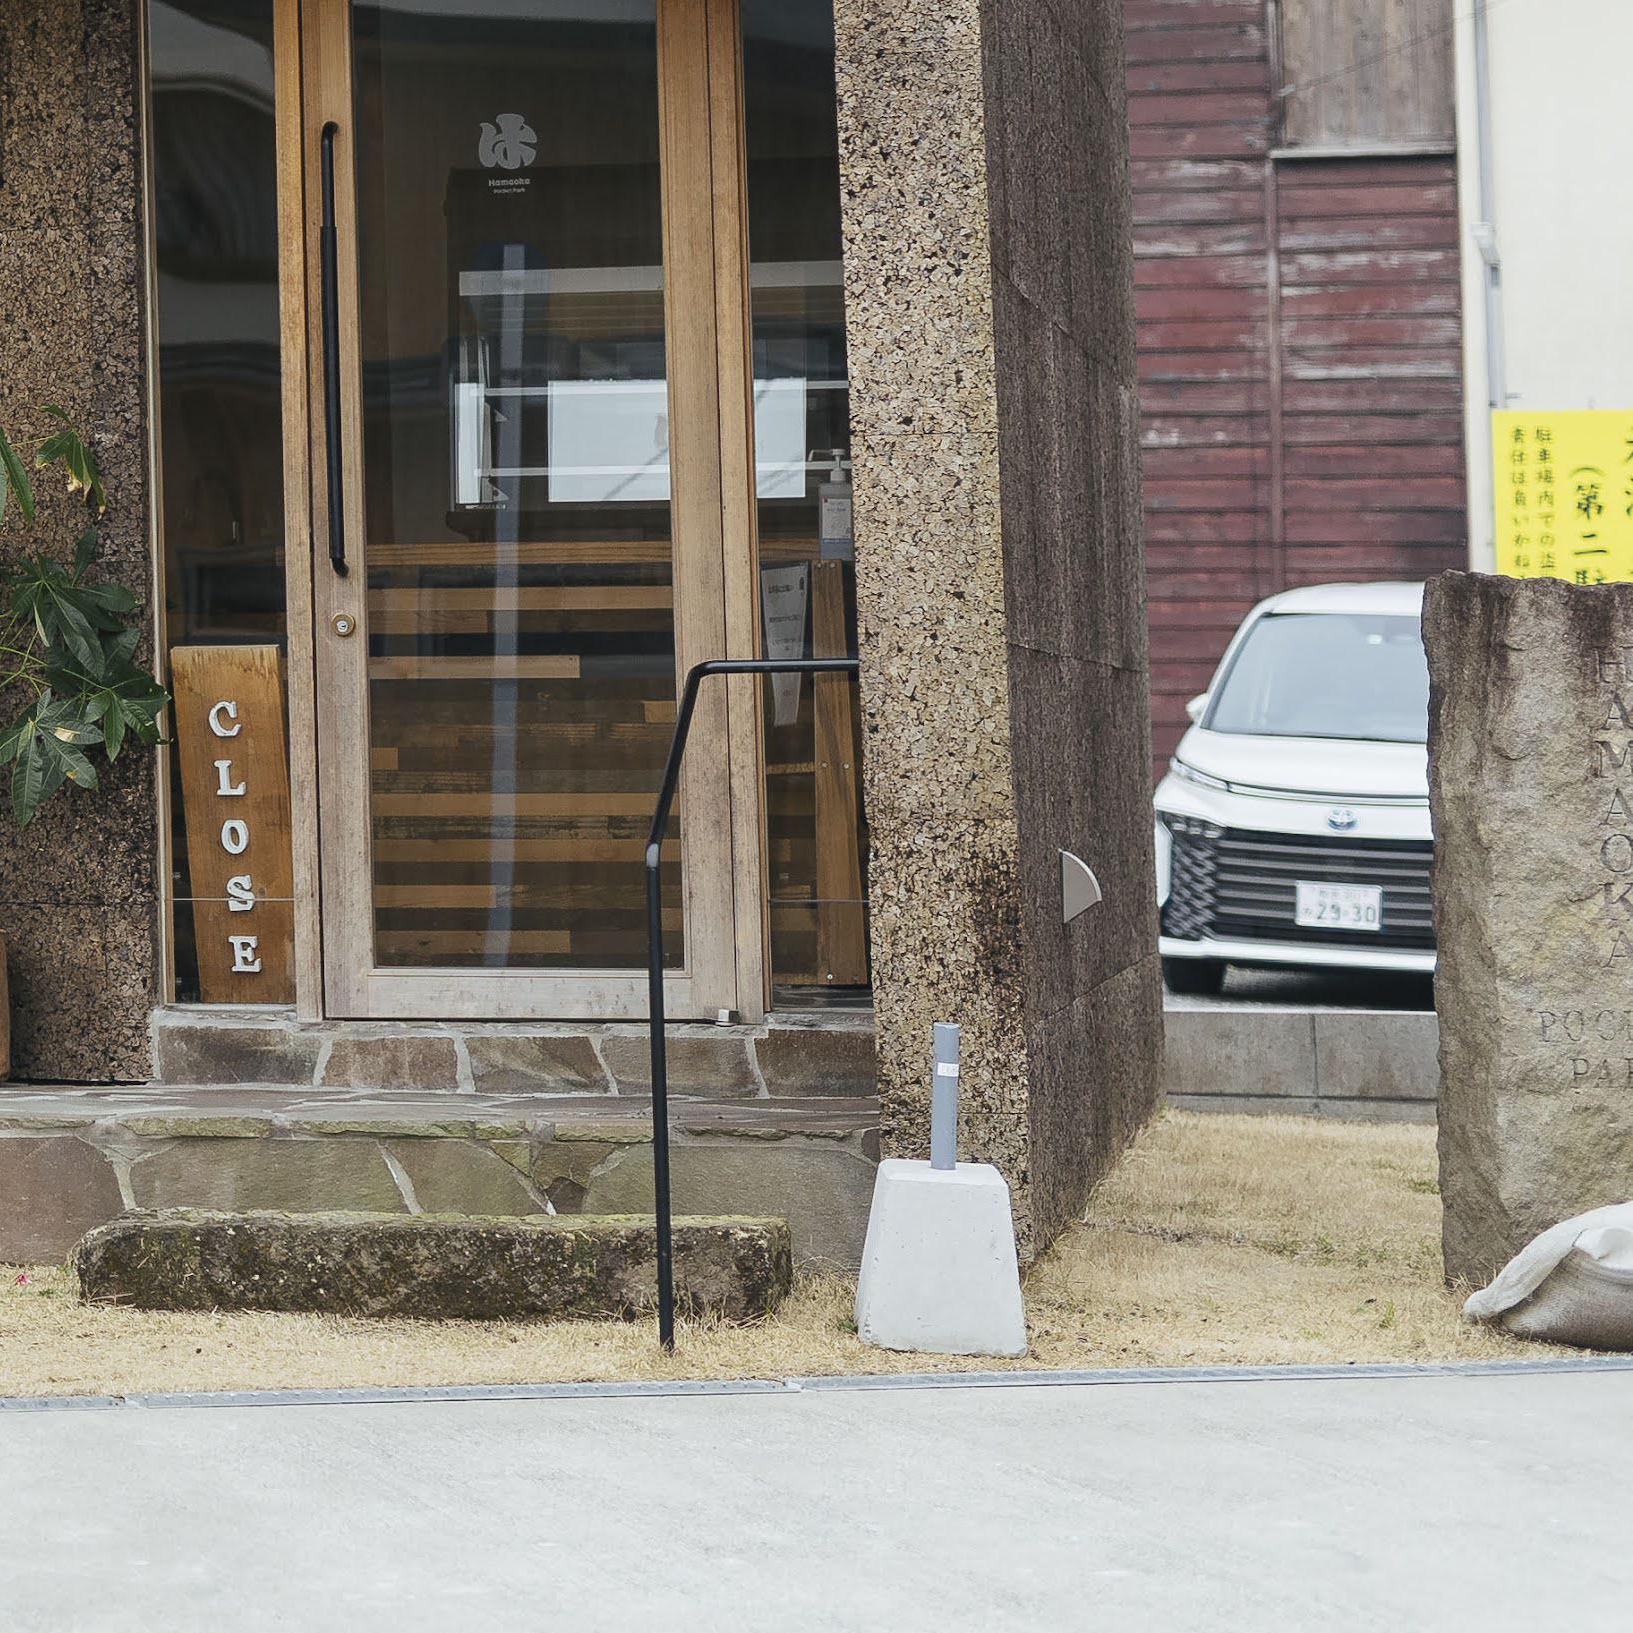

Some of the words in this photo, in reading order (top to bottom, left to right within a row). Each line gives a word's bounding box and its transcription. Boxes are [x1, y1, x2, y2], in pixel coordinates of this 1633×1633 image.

[208, 700, 263, 973] CLOSE
[1537, 1008, 1633, 1043] POC
[1568, 1058, 1633, 1089] PA
